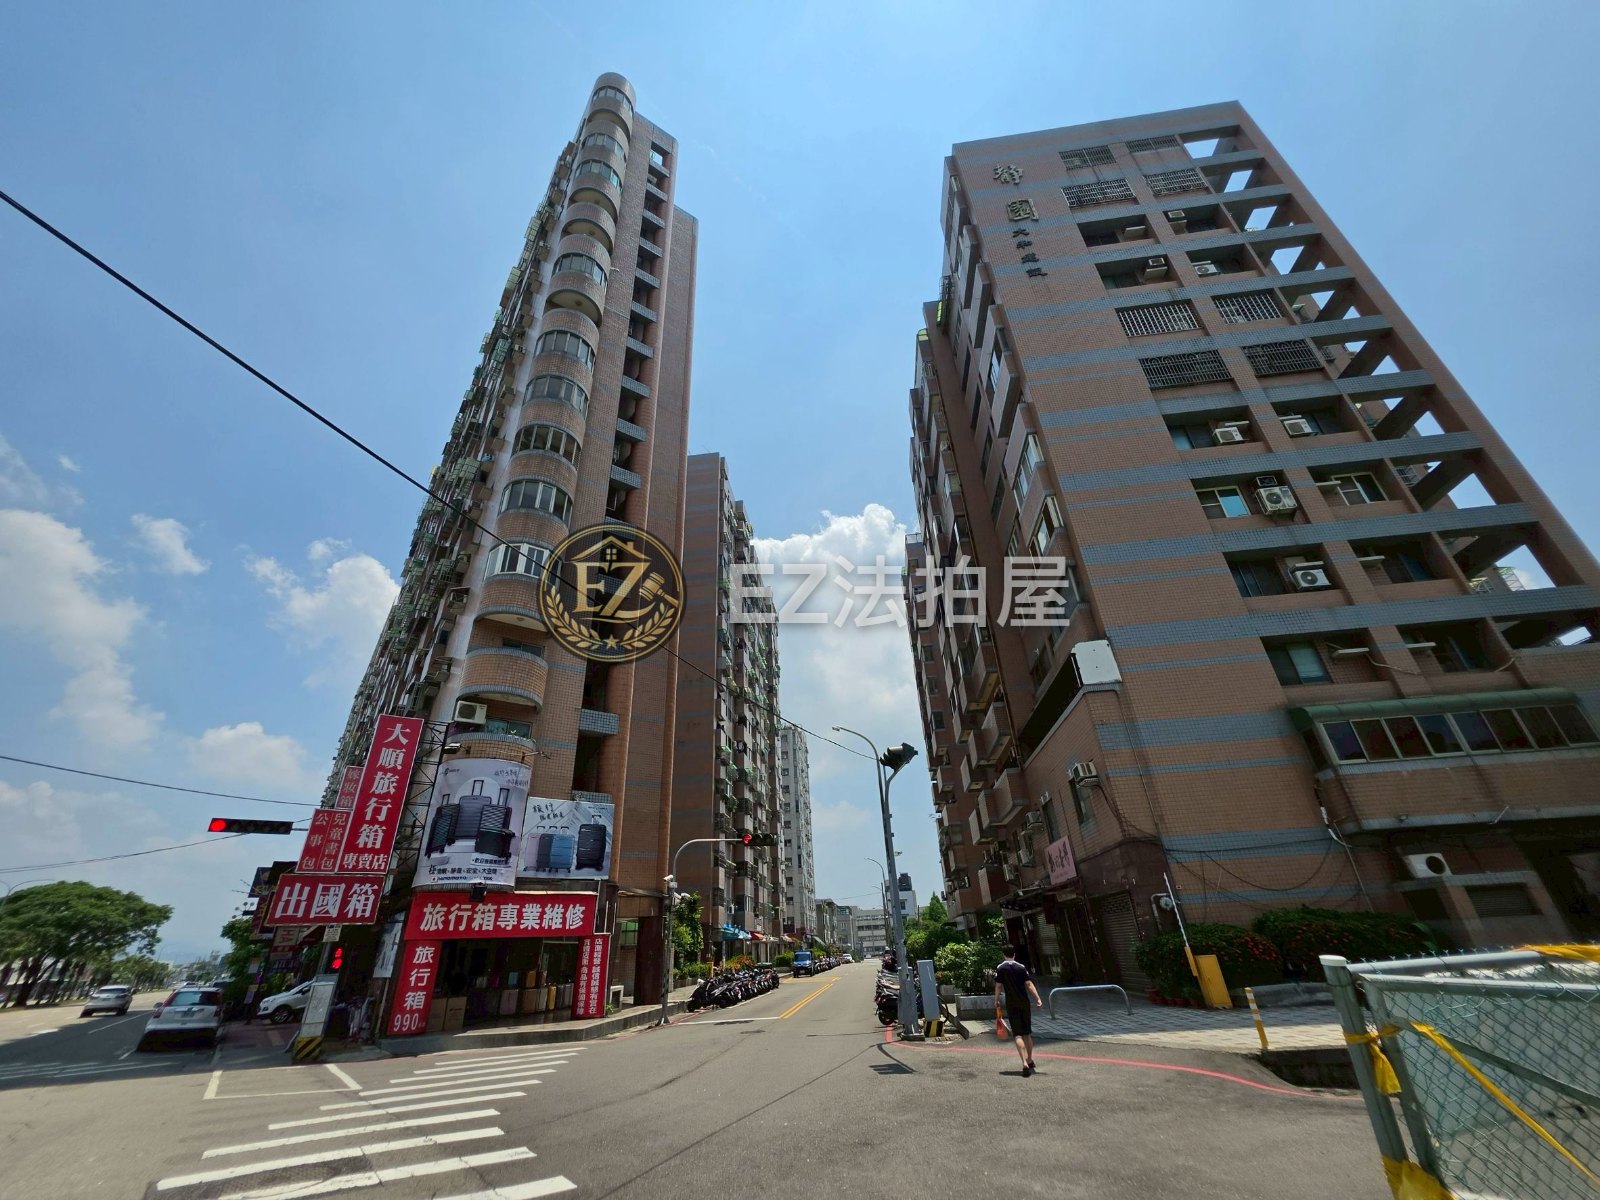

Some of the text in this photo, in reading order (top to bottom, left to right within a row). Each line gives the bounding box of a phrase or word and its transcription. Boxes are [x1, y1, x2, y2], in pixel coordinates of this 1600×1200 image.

[356, 723, 412, 849] 大順旅行箱
[302, 812, 329, 870] 公事包
[321, 812, 347, 870] 兒童書包
[342, 852, 388, 871] 專賣店
[274, 882, 378, 919] 出國箱
[420, 903, 586, 931] 旅行箱專業維修
[403, 945, 436, 1011] 旅行箱
[393, 1013, 419, 1032] 990
